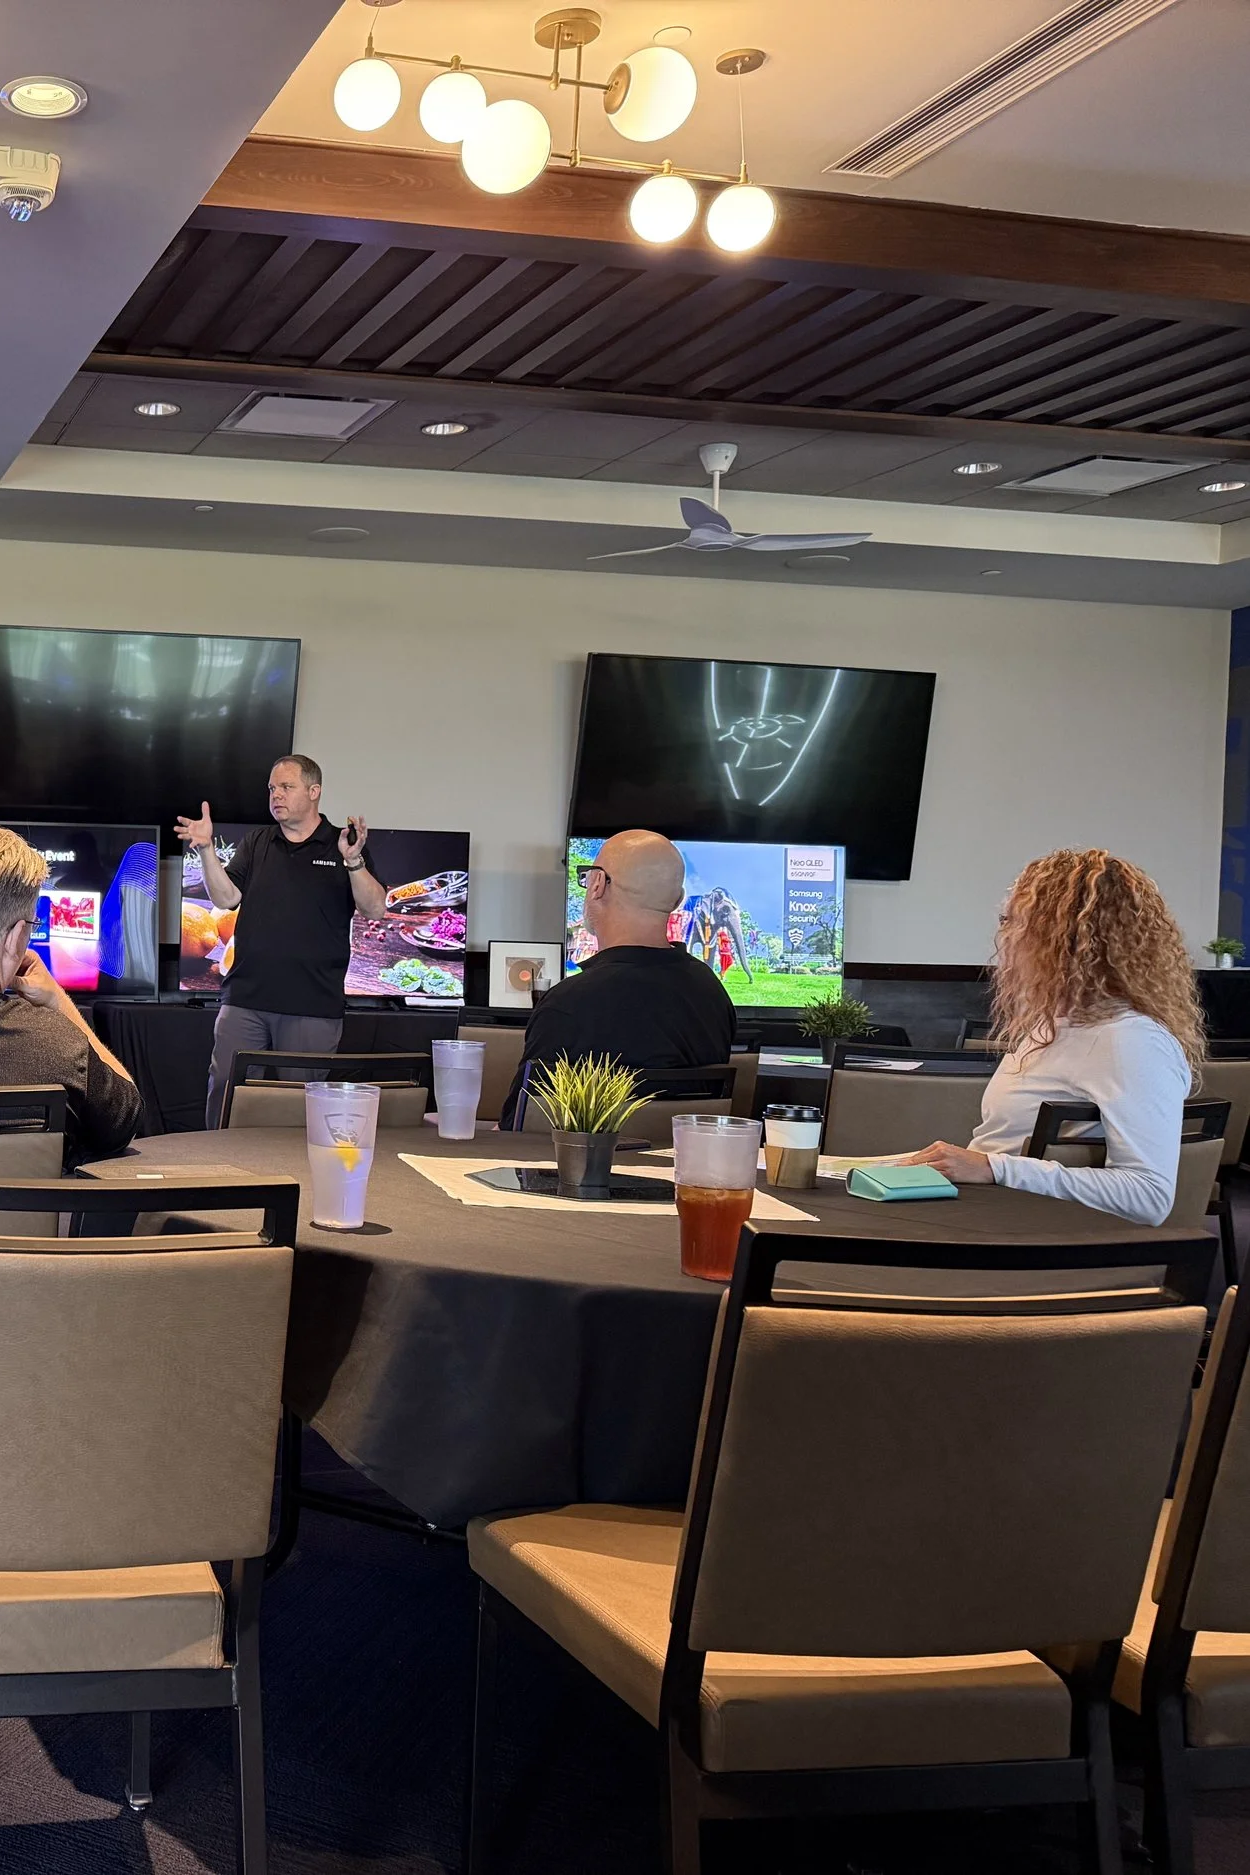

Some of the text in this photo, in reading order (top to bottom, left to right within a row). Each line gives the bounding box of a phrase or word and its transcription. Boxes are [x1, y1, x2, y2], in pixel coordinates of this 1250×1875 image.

[45, 849, 75, 862] Event
[789, 859, 824, 867] Neo QLED
[789, 890, 822, 899] Samsung
[789, 901, 817, 912] Knox
[789, 915, 819, 924] Security
